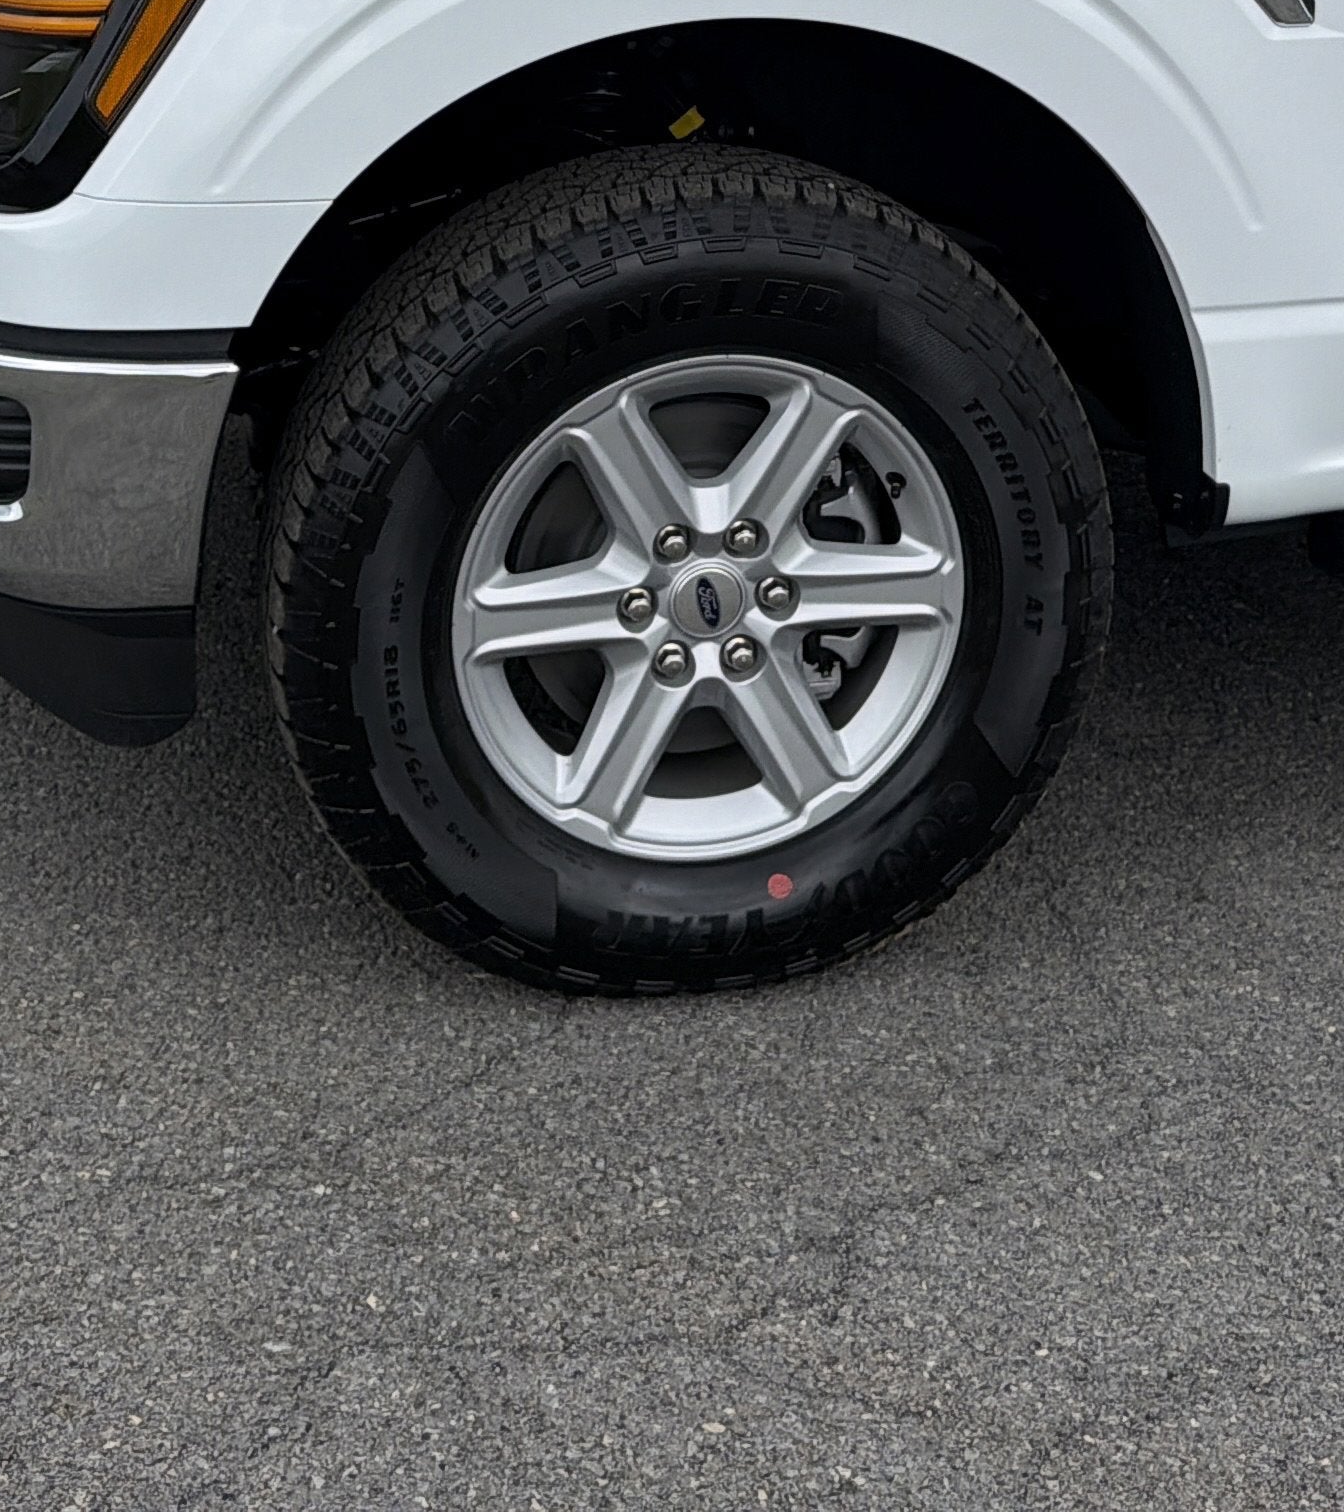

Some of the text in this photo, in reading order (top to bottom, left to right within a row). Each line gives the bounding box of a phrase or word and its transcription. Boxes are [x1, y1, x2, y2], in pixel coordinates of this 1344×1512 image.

[962, 397, 1044, 636] TERRITORY AT
[698, 586, 718, 620] Ford
[383, 644, 440, 810] 275/65R18
